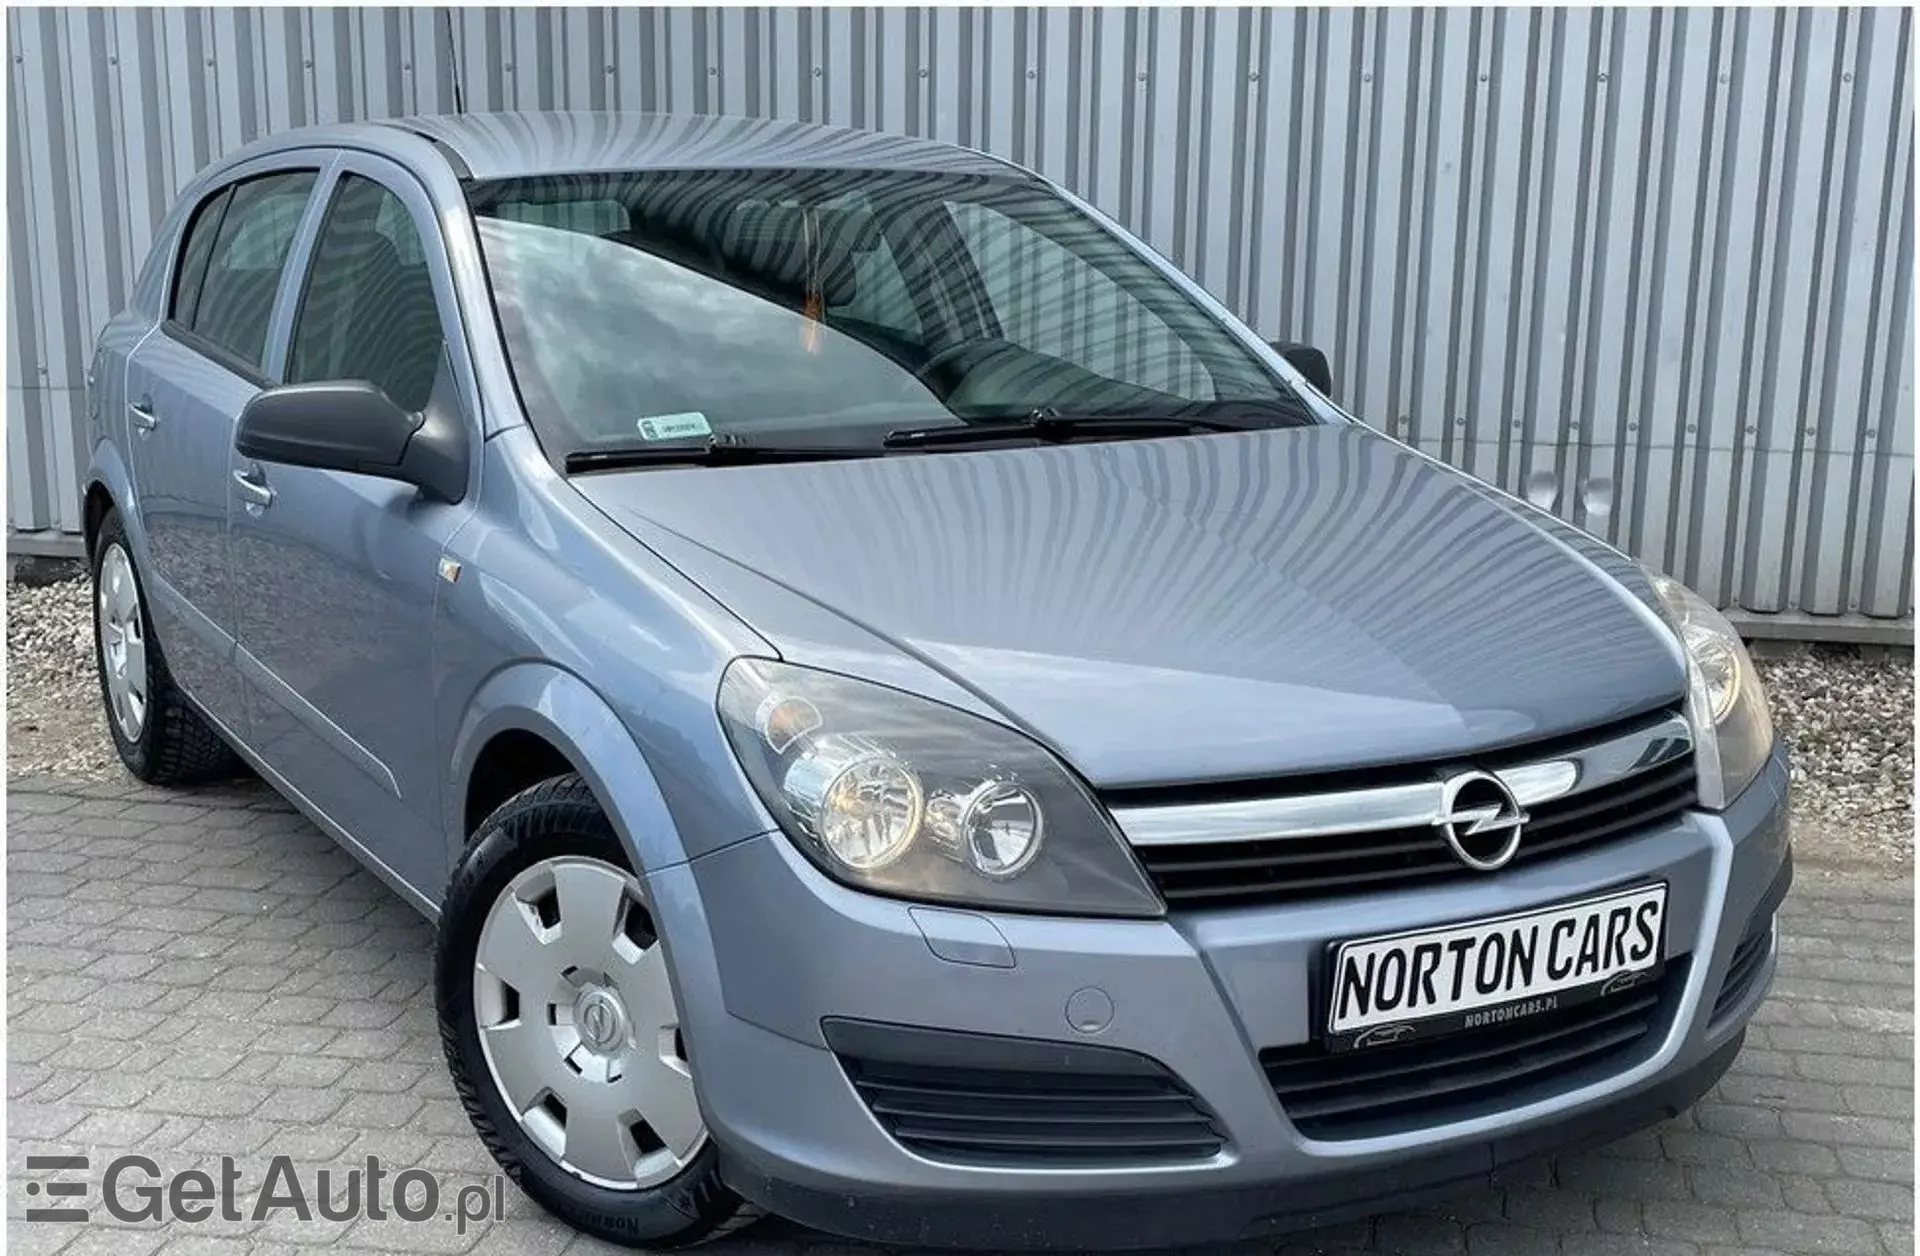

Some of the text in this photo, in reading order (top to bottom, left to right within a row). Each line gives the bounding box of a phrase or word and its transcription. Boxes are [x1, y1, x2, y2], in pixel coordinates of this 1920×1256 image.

[1338, 900, 1658, 1020] NORTON CARS
[1465, 995, 1558, 1029] NORTONCARS.PL
